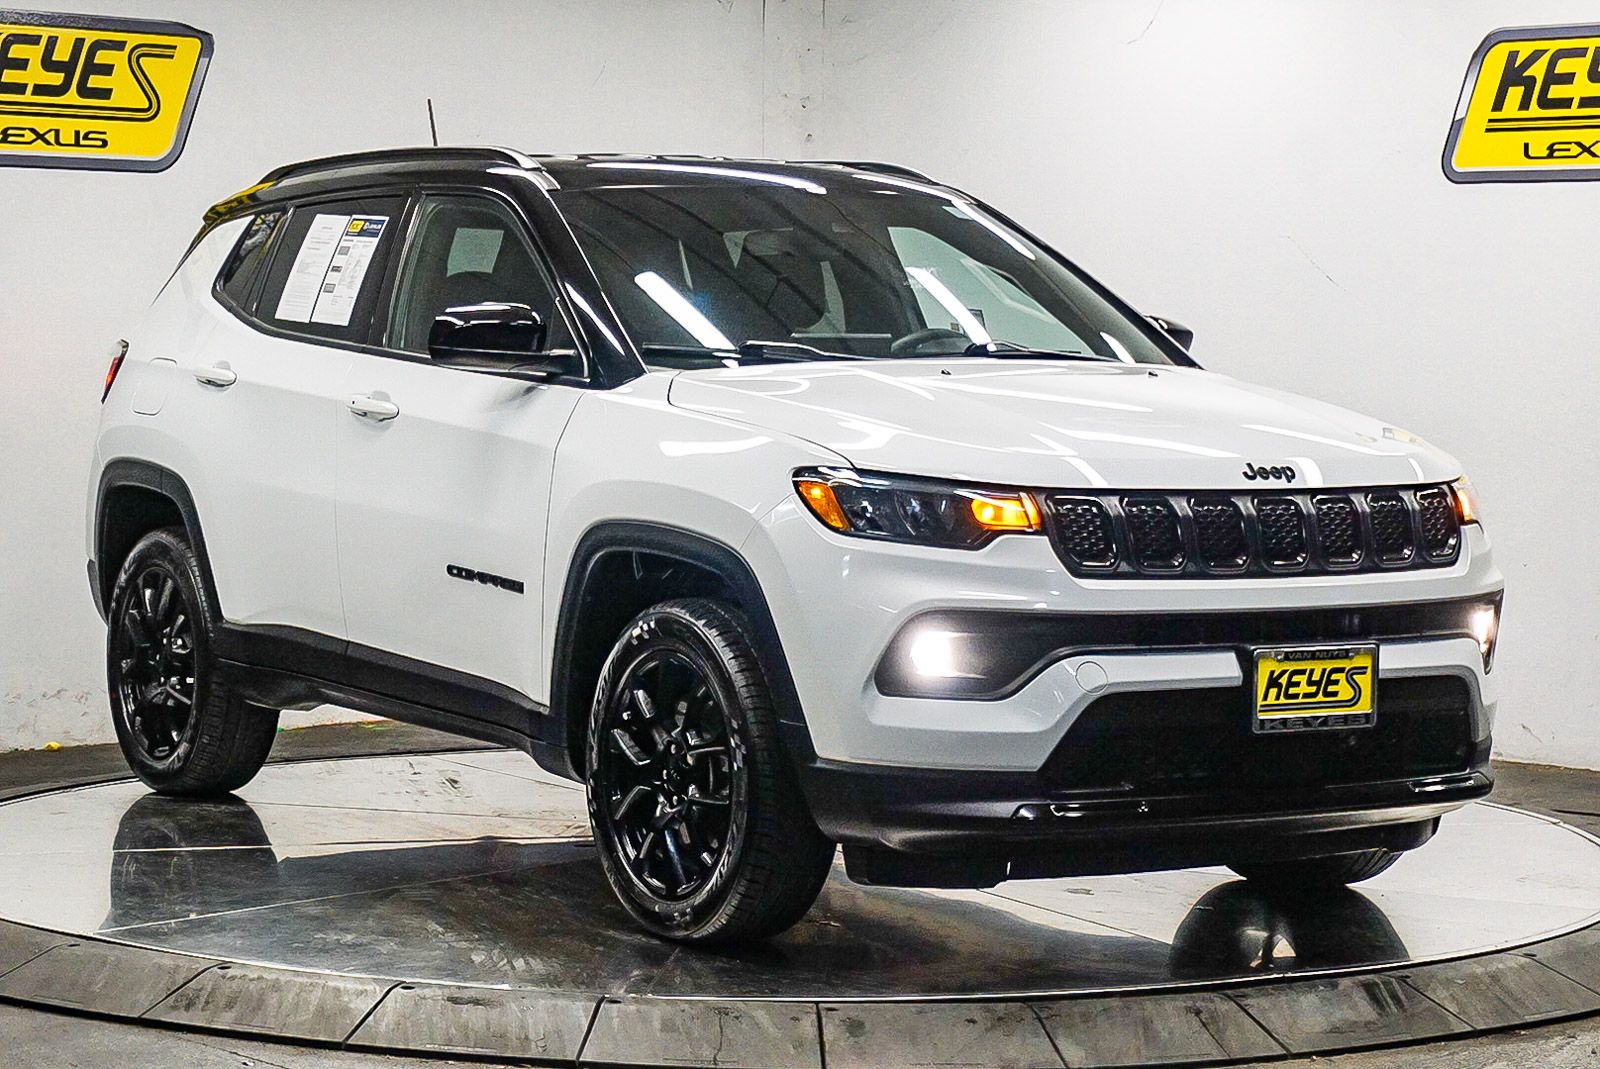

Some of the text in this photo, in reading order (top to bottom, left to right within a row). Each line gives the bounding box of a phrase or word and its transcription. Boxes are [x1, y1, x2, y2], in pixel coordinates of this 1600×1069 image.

[0, 32, 178, 123] EYES
[0, 127, 109, 149] EXUS
[1242, 462, 1296, 483] Jeep
[1288, 651, 1312, 660] VAN
[1260, 665, 1369, 709] KEYES
[1263, 714, 1367, 730] KEYES
